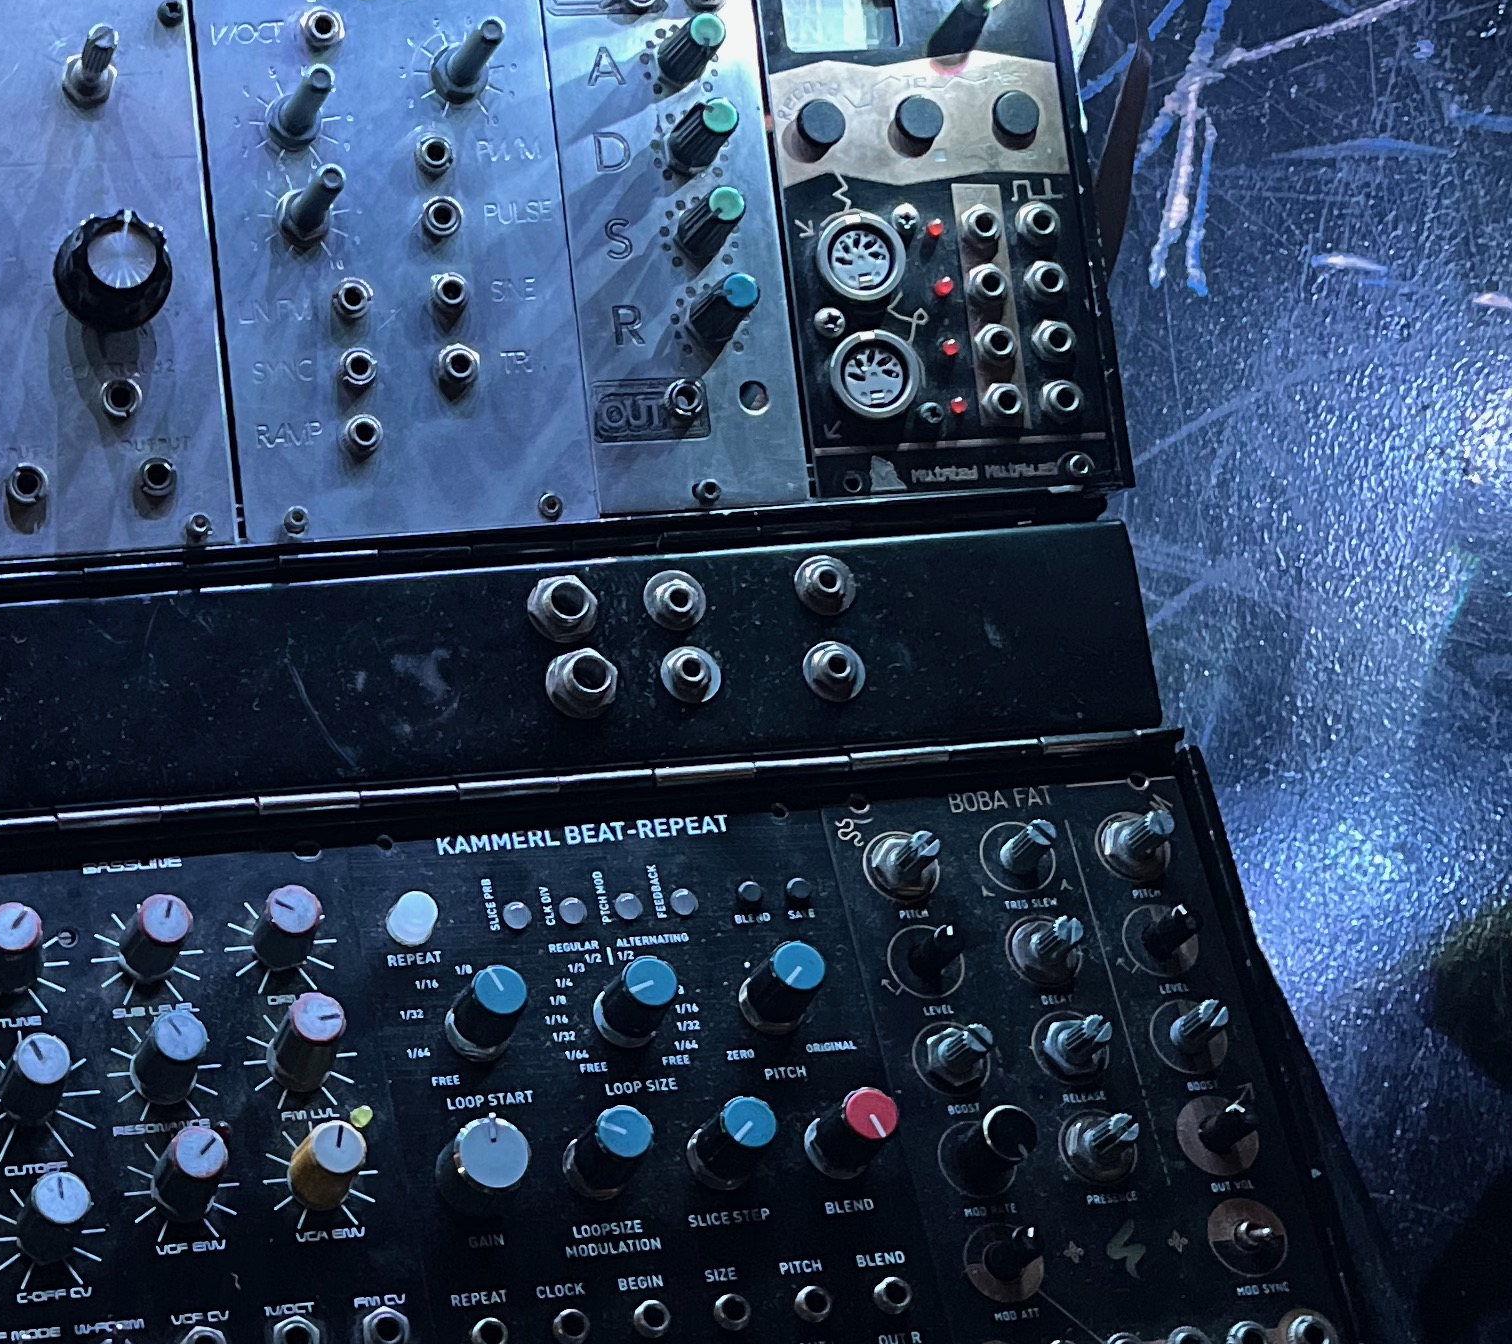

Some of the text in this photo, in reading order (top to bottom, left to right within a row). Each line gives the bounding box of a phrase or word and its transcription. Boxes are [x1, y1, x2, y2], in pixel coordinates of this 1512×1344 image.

[588, 47, 626, 86] A
[593, 132, 631, 172] D
[484, 199, 553, 224] PULSE
[605, 218, 632, 259] S
[612, 305, 645, 346] R
[253, 360, 312, 384] SYNC
[257, 422, 322, 449] RAMP
[948, 786, 1052, 814] BOBA FAT
[437, 814, 728, 855] KAMMERL BEAT-REPEAT
[82, 857, 182, 874] BASSLINE
[647, 864, 667, 919] FEEDBACK
[898, 908, 929, 919] PITCH
[548, 940, 599, 954] REGULAR
[616, 933, 689, 947] ALTERNATING
[387, 951, 441, 967] REPEAT
[923, 1005, 954, 1016] LEVEL
[726, 1049, 755, 1060] ZERO
[806, 1040, 856, 1053] ORIGINAL
[580, 1061, 608, 1074] FREE
[764, 1065, 807, 1080] PITCH
[432, 1075, 460, 1087] FREE
[605, 1077, 677, 1096] LOOP SIZE
[447, 1090, 534, 1111] LOOP START
[1062, 1091, 1106, 1104] RELEASE
[113, 1119, 210, 1136] RESONANCE
[824, 1198, 874, 1214] BLEND
[1086, 1191, 1137, 1205] PRESENCE
[688, 1207, 770, 1228] SLICE STEP
[572, 1219, 643, 1239] LOOPSIZE
[469, 1234, 504, 1248] GAIN
[565, 1237, 662, 1259] MODULATION
[779, 1259, 823, 1275] PITCH
[855, 1251, 905, 1267] BLEND
[618, 1275, 664, 1291] BEGIN
[705, 1267, 738, 1283] SIZE
[451, 1289, 508, 1307] REPEAT
[536, 1282, 586, 1299] CLOCK
[171, 1311, 229, 1325] VCF CV
[912, 1332, 922, 1344] R
